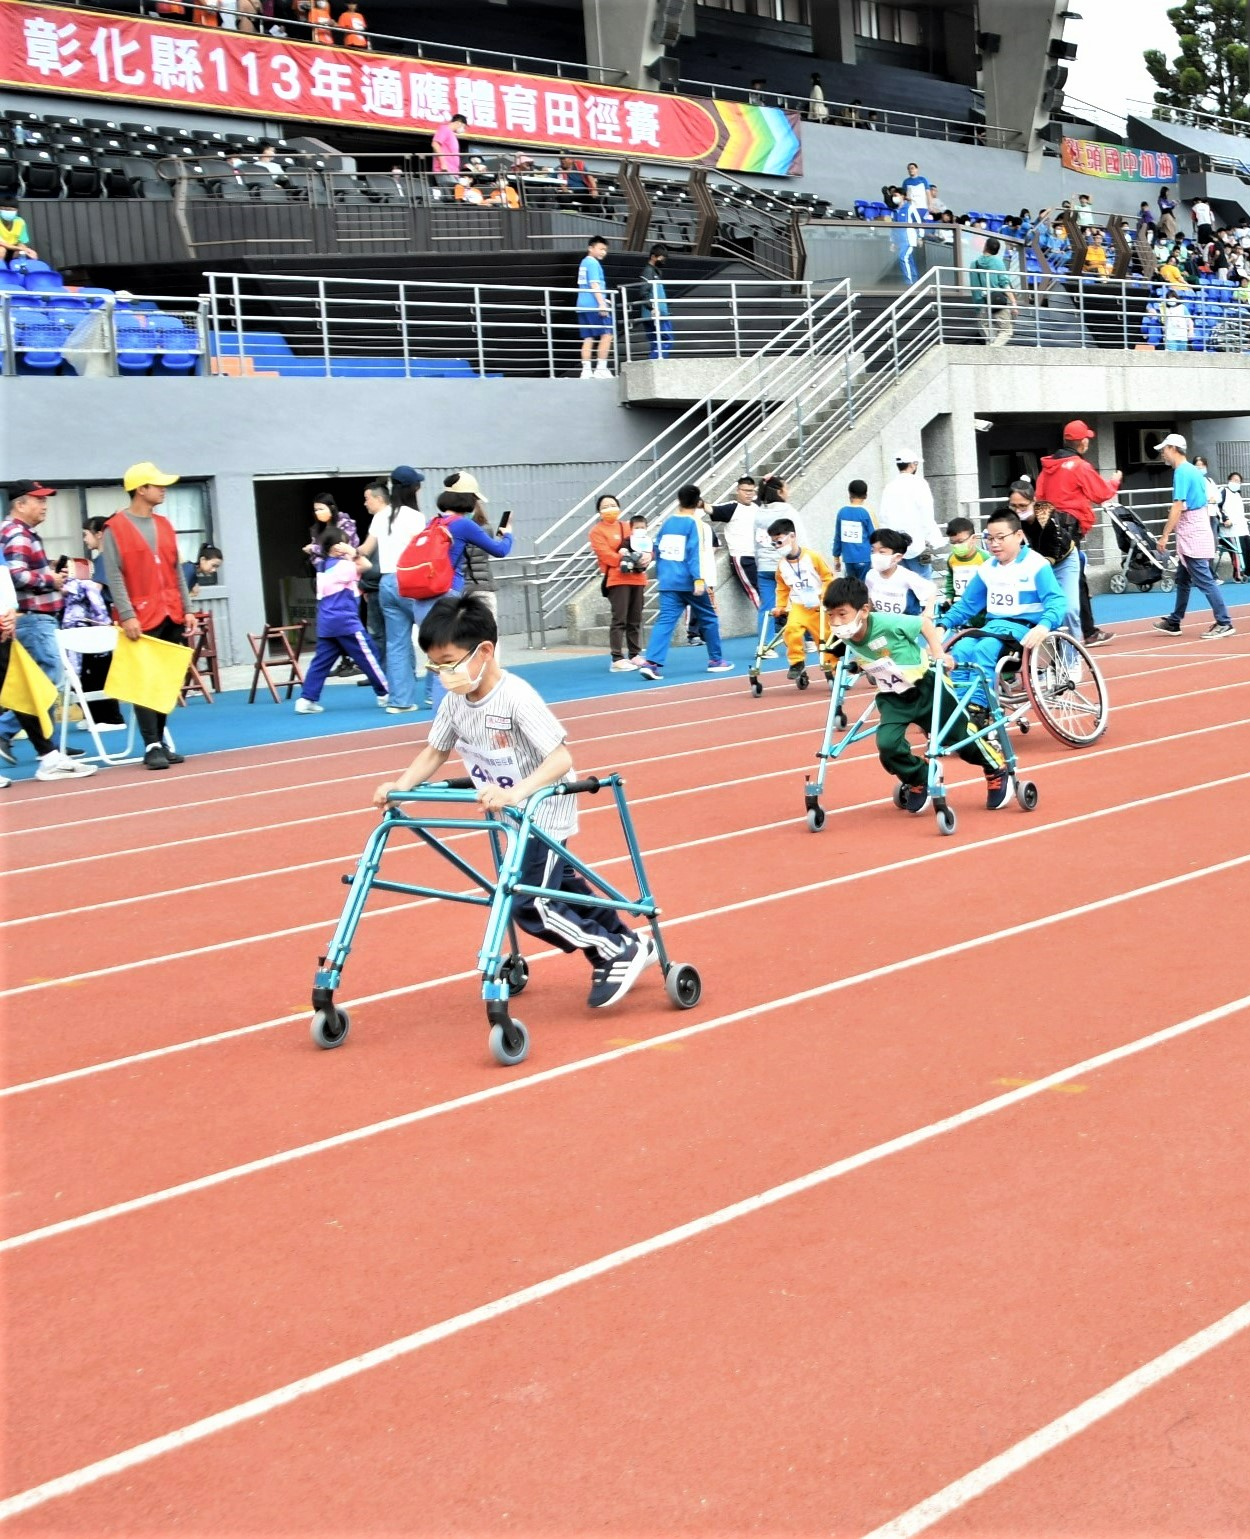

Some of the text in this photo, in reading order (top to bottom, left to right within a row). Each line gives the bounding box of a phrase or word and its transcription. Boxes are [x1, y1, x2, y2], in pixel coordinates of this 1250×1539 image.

[23, 17, 660, 148] 彰化縣113年適應體育田徑賽
[875, 599, 902, 615] 656
[990, 592, 1013, 606] 529
